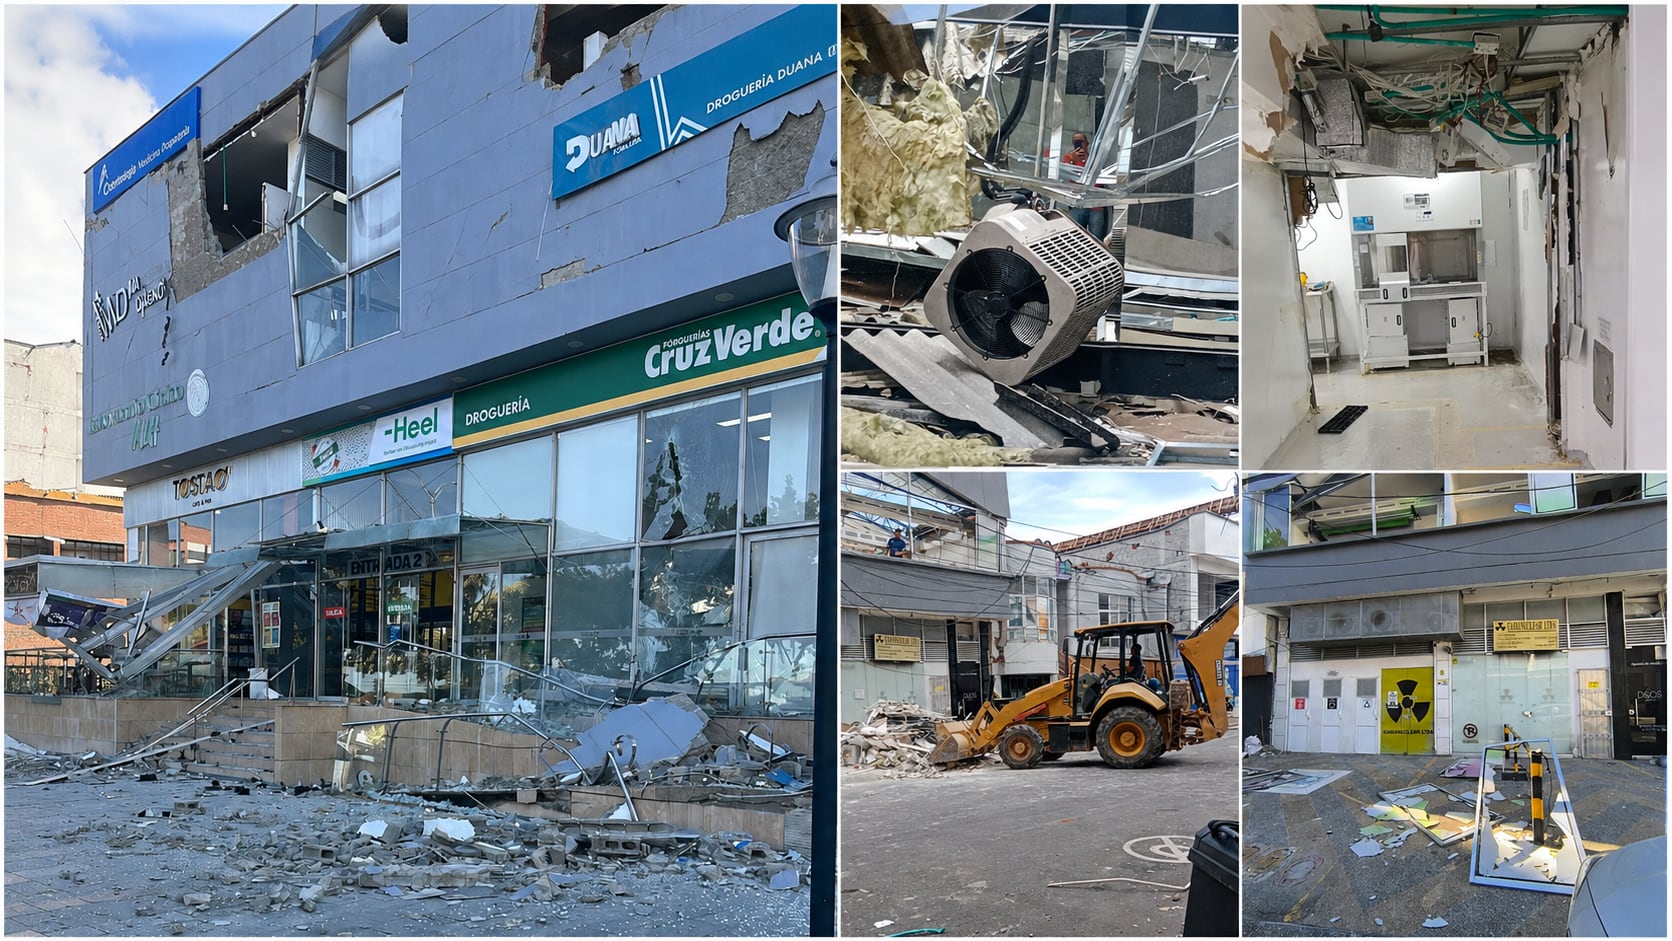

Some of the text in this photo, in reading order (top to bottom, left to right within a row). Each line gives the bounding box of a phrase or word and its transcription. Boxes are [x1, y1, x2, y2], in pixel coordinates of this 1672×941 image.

[777, 51, 823, 81] DUANA
[565, 112, 640, 173] DUANA
[644, 307, 815, 379] Cruz Verde
[465, 395, 531, 426] DROGUERÍA
[412, 552, 423, 569] 2
